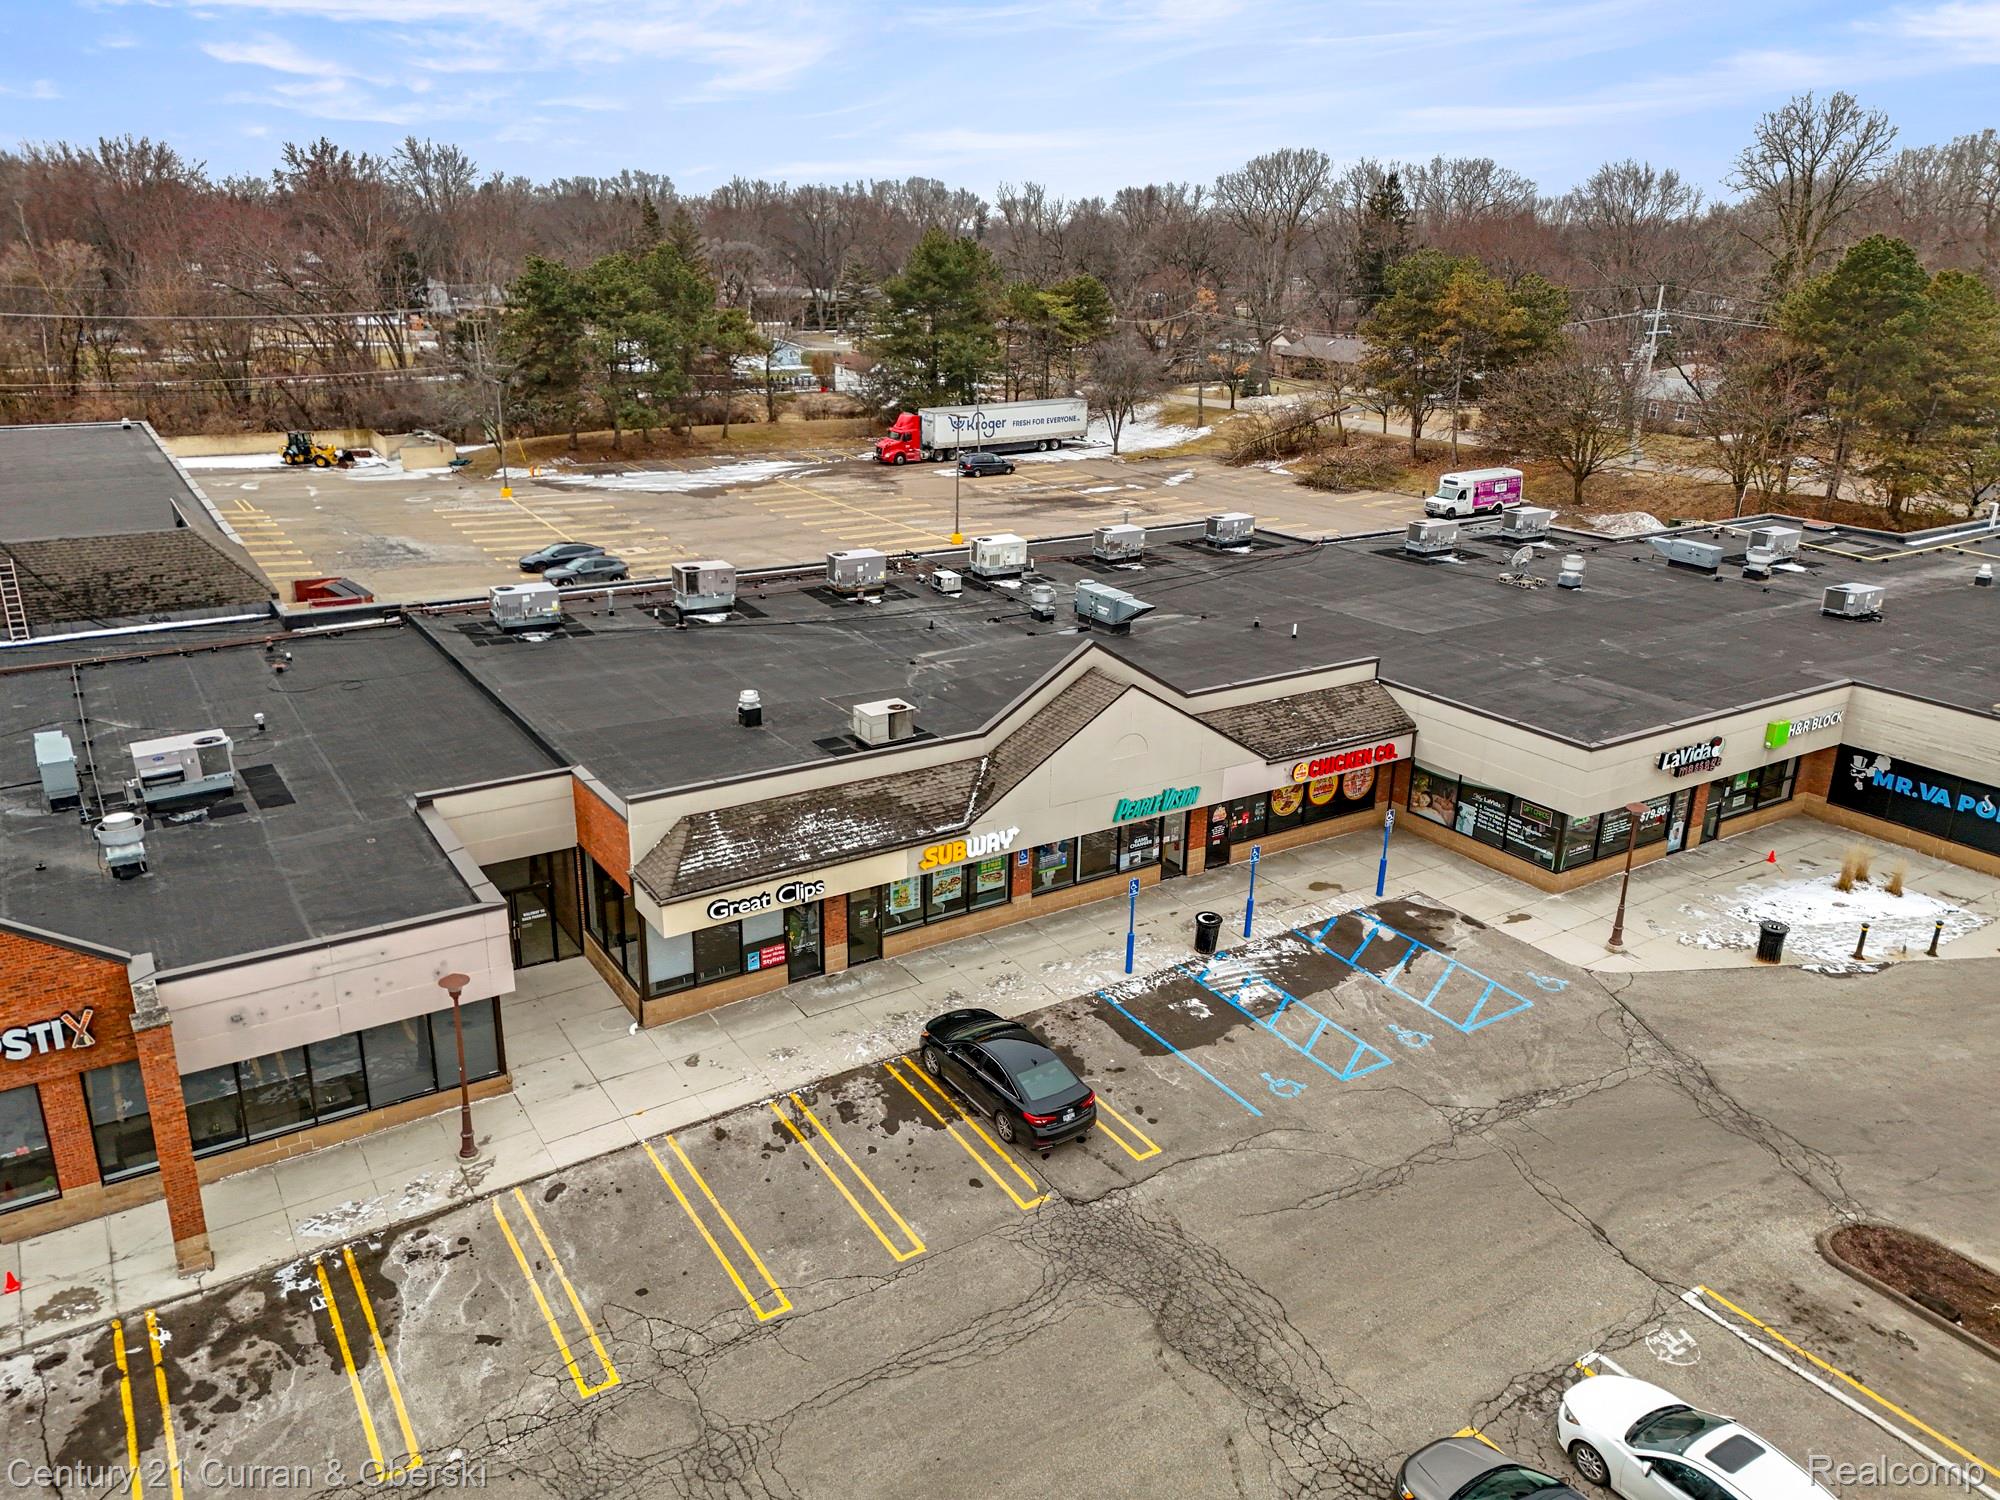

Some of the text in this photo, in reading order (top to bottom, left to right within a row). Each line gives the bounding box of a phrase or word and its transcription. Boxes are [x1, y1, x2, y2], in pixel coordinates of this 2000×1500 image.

[967, 411, 1007, 438] Kroger
[1012, 419, 1031, 428] FRESH
[1046, 414, 1077, 424] EVERYONE
[1788, 711, 1844, 737] H&R BLOCK
[1308, 748, 1373, 779] CHICKEN
[1113, 786, 1202, 823] PEARLE VISION
[919, 826, 1021, 871] SUBWAY
[708, 880, 825, 920] Great Clips
[0, 1008, 96, 1061] STIX
